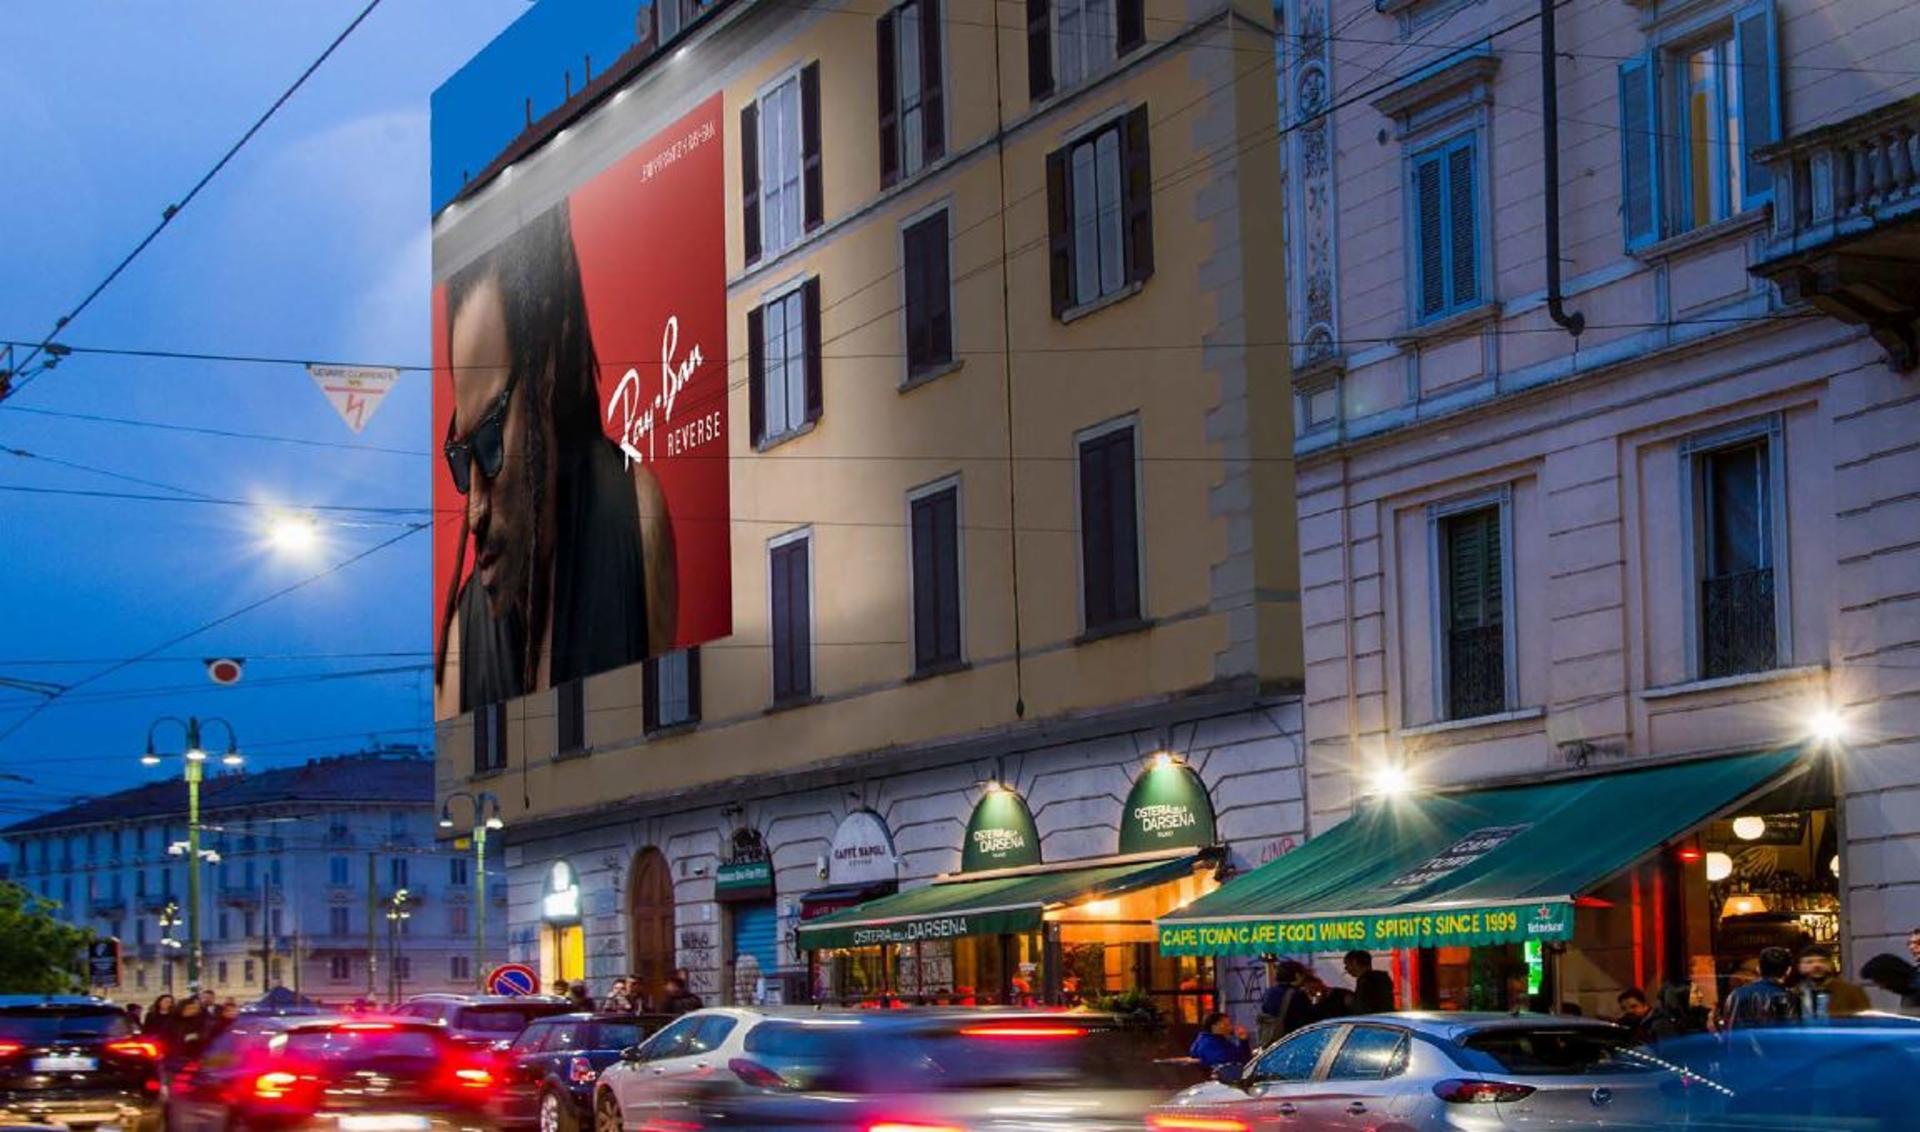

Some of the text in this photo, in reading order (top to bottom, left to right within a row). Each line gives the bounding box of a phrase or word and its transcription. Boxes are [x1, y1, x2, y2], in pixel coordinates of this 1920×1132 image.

[668, 411, 720, 457] REVERSE
[1143, 812, 1195, 832] DARSENA
[858, 844, 886, 857] NAPOLI
[980, 836, 1025, 853] DARSENA
[854, 928, 891, 944] OSTERIA
[907, 917, 968, 940] DARSENA
[1162, 929, 1197, 946] CAPE
[1200, 926, 1238, 945] TOWN
[1279, 922, 1315, 942] FOOD
[1319, 920, 1365, 940] WINES
[1375, 916, 1431, 938] SPIRITS
[1435, 914, 1480, 934] SINCE
[1485, 912, 1517, 931] 1999
